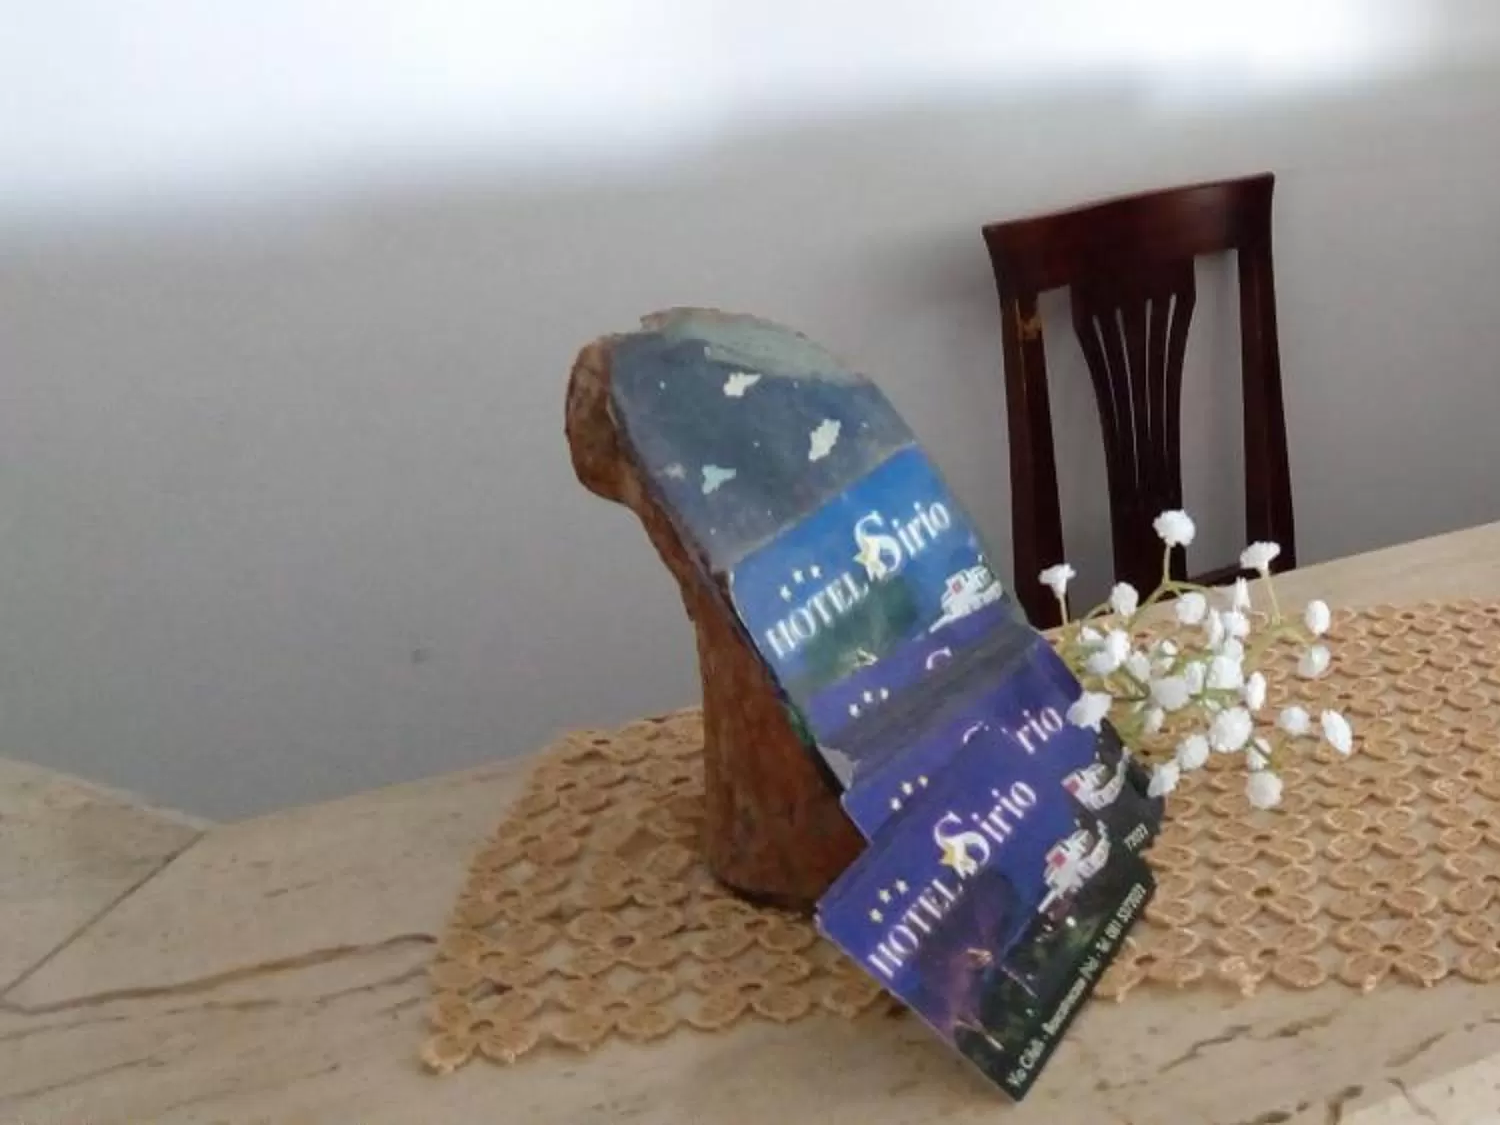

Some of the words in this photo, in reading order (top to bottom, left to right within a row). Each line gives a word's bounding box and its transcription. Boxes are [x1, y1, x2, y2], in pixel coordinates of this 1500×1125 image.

[765, 572, 870, 659] HOTEL
[853, 501, 950, 582] Sirio
[867, 877, 964, 980] HOTEL
[933, 780, 1037, 879] Sirio
